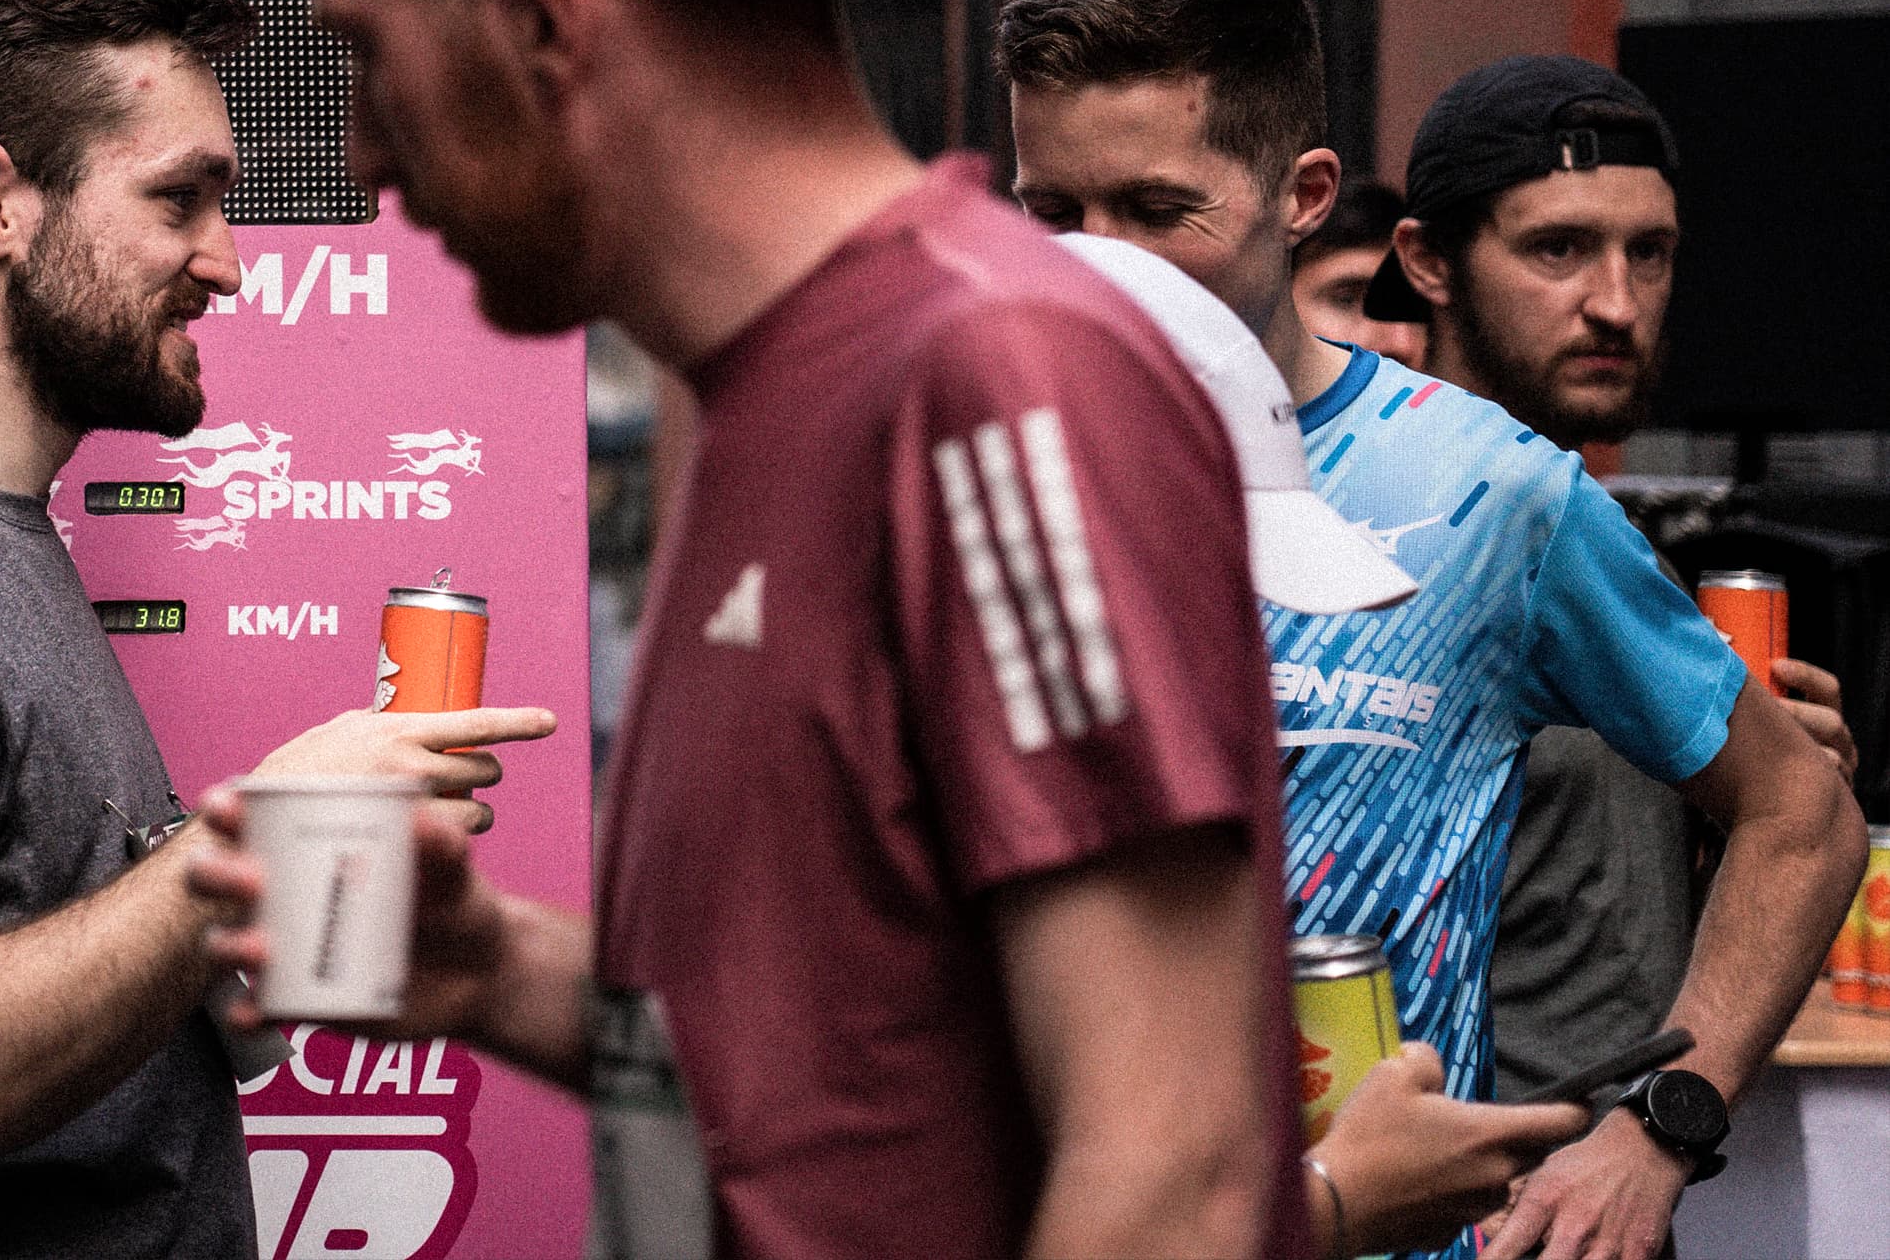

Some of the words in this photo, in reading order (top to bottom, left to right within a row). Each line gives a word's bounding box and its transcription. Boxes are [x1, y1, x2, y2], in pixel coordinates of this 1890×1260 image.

[204, 244, 388, 326] M/H
[221, 480, 452, 521] SPRINTS
[227, 601, 339, 641] KM/H
